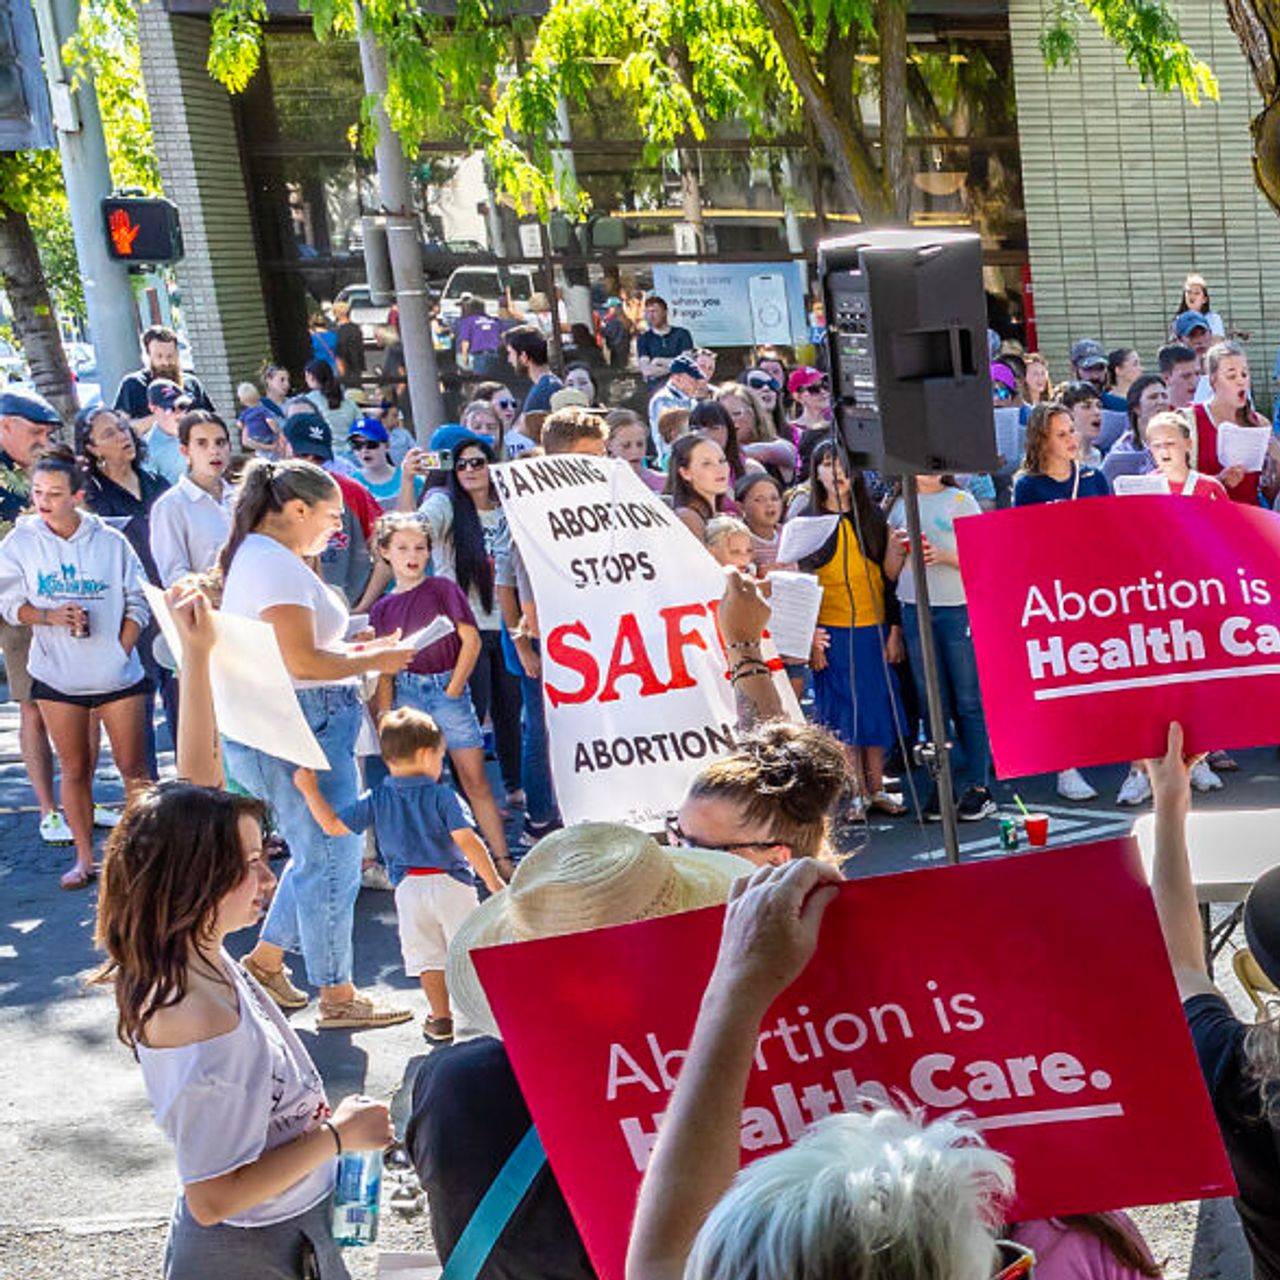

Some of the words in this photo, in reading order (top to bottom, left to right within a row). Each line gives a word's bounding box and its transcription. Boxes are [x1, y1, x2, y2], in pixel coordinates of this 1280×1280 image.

[495, 457, 608, 499] BANNING
[547, 502, 671, 541] ABORTION
[570, 551, 656, 589] STOPS
[1021, 570, 1227, 628] Abortion
[1236, 567, 1272, 606] is
[544, 599, 784, 709] SAF
[1026, 618, 1207, 680] Health
[574, 722, 738, 773] ABORTION
[606, 1003, 914, 1101] Abrtion
[926, 979, 985, 1034] is
[909, 1051, 1112, 1109] Care.
